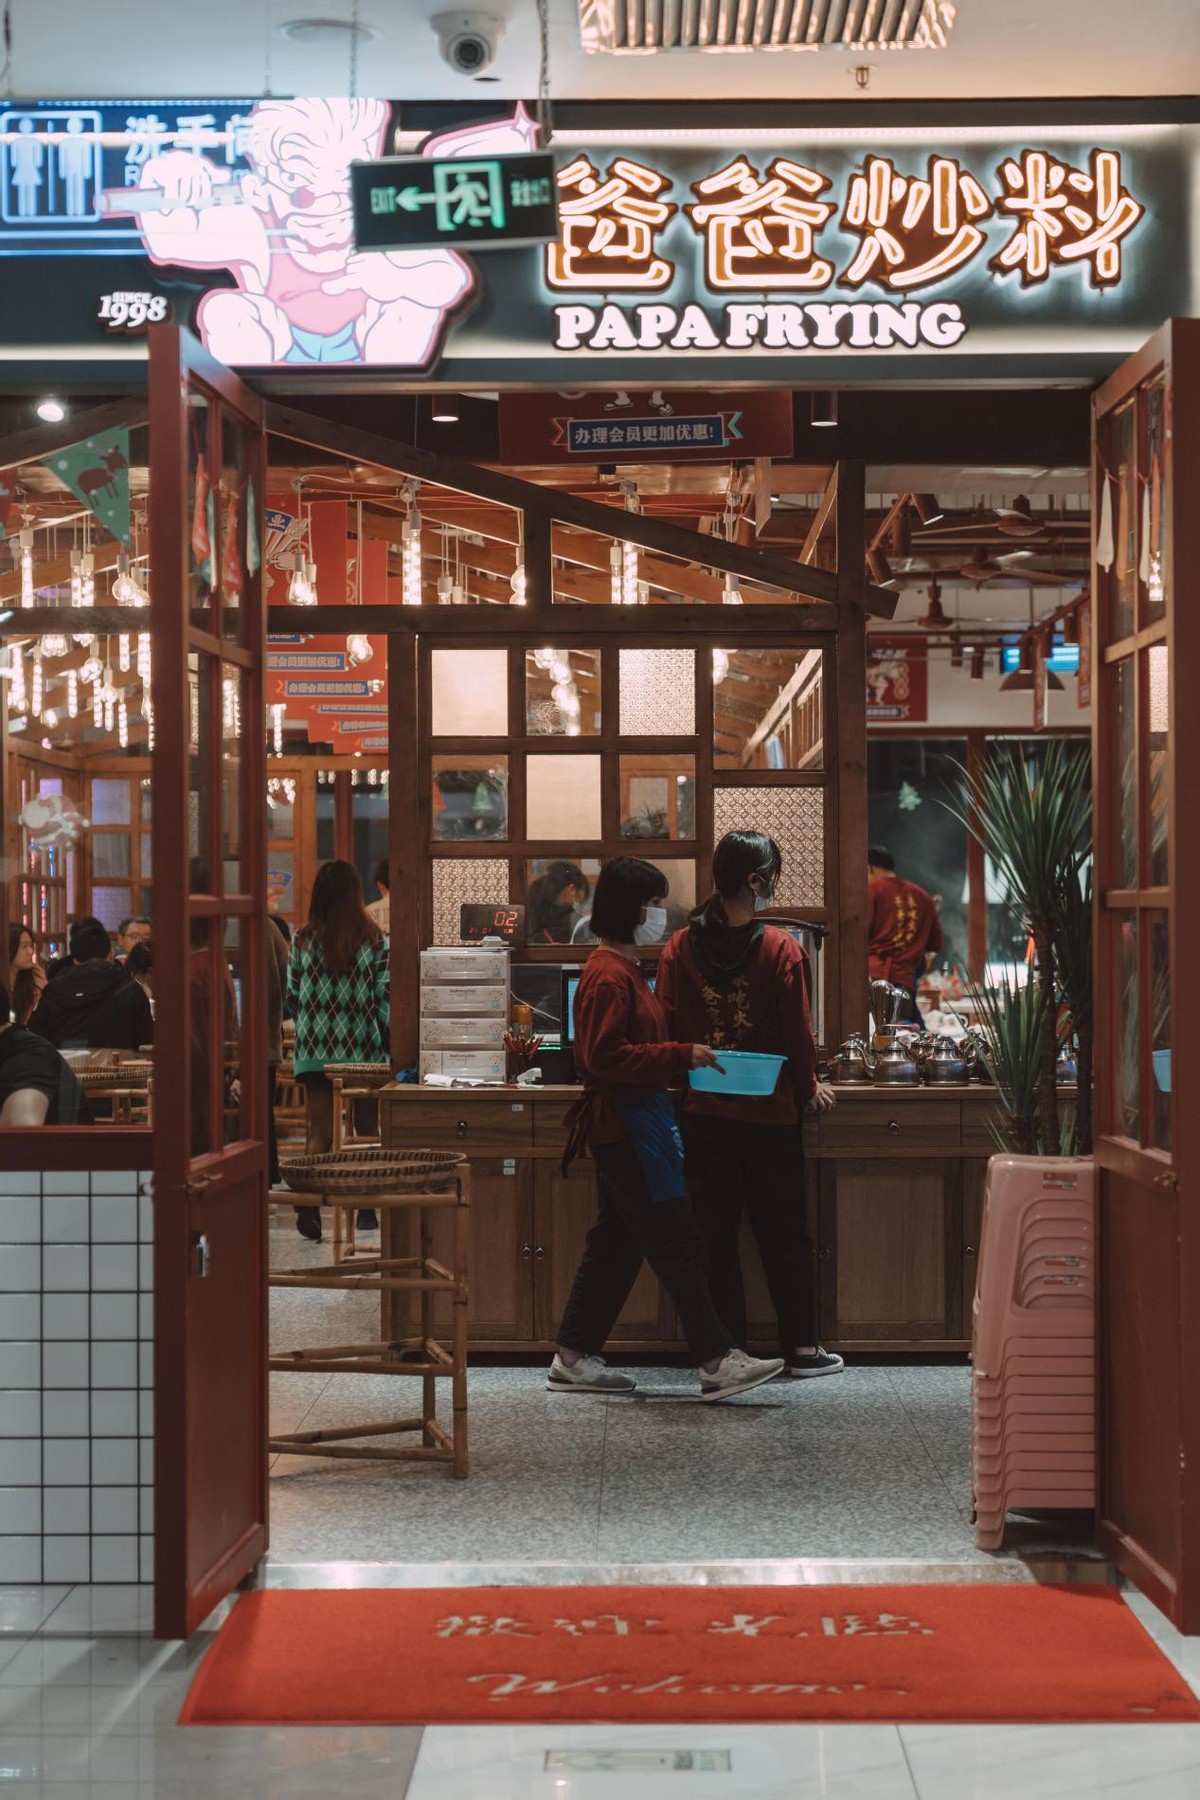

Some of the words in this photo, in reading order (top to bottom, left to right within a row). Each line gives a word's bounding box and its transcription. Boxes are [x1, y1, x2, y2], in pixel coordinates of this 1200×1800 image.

[546, 150, 1143, 290] 爸爸炒料
[98, 295, 168, 327] 1998
[554, 303, 719, 348] PAPA
[726, 303, 965, 348] FRYING
[575, 423, 714, 445] 办理会员更加优惠!
